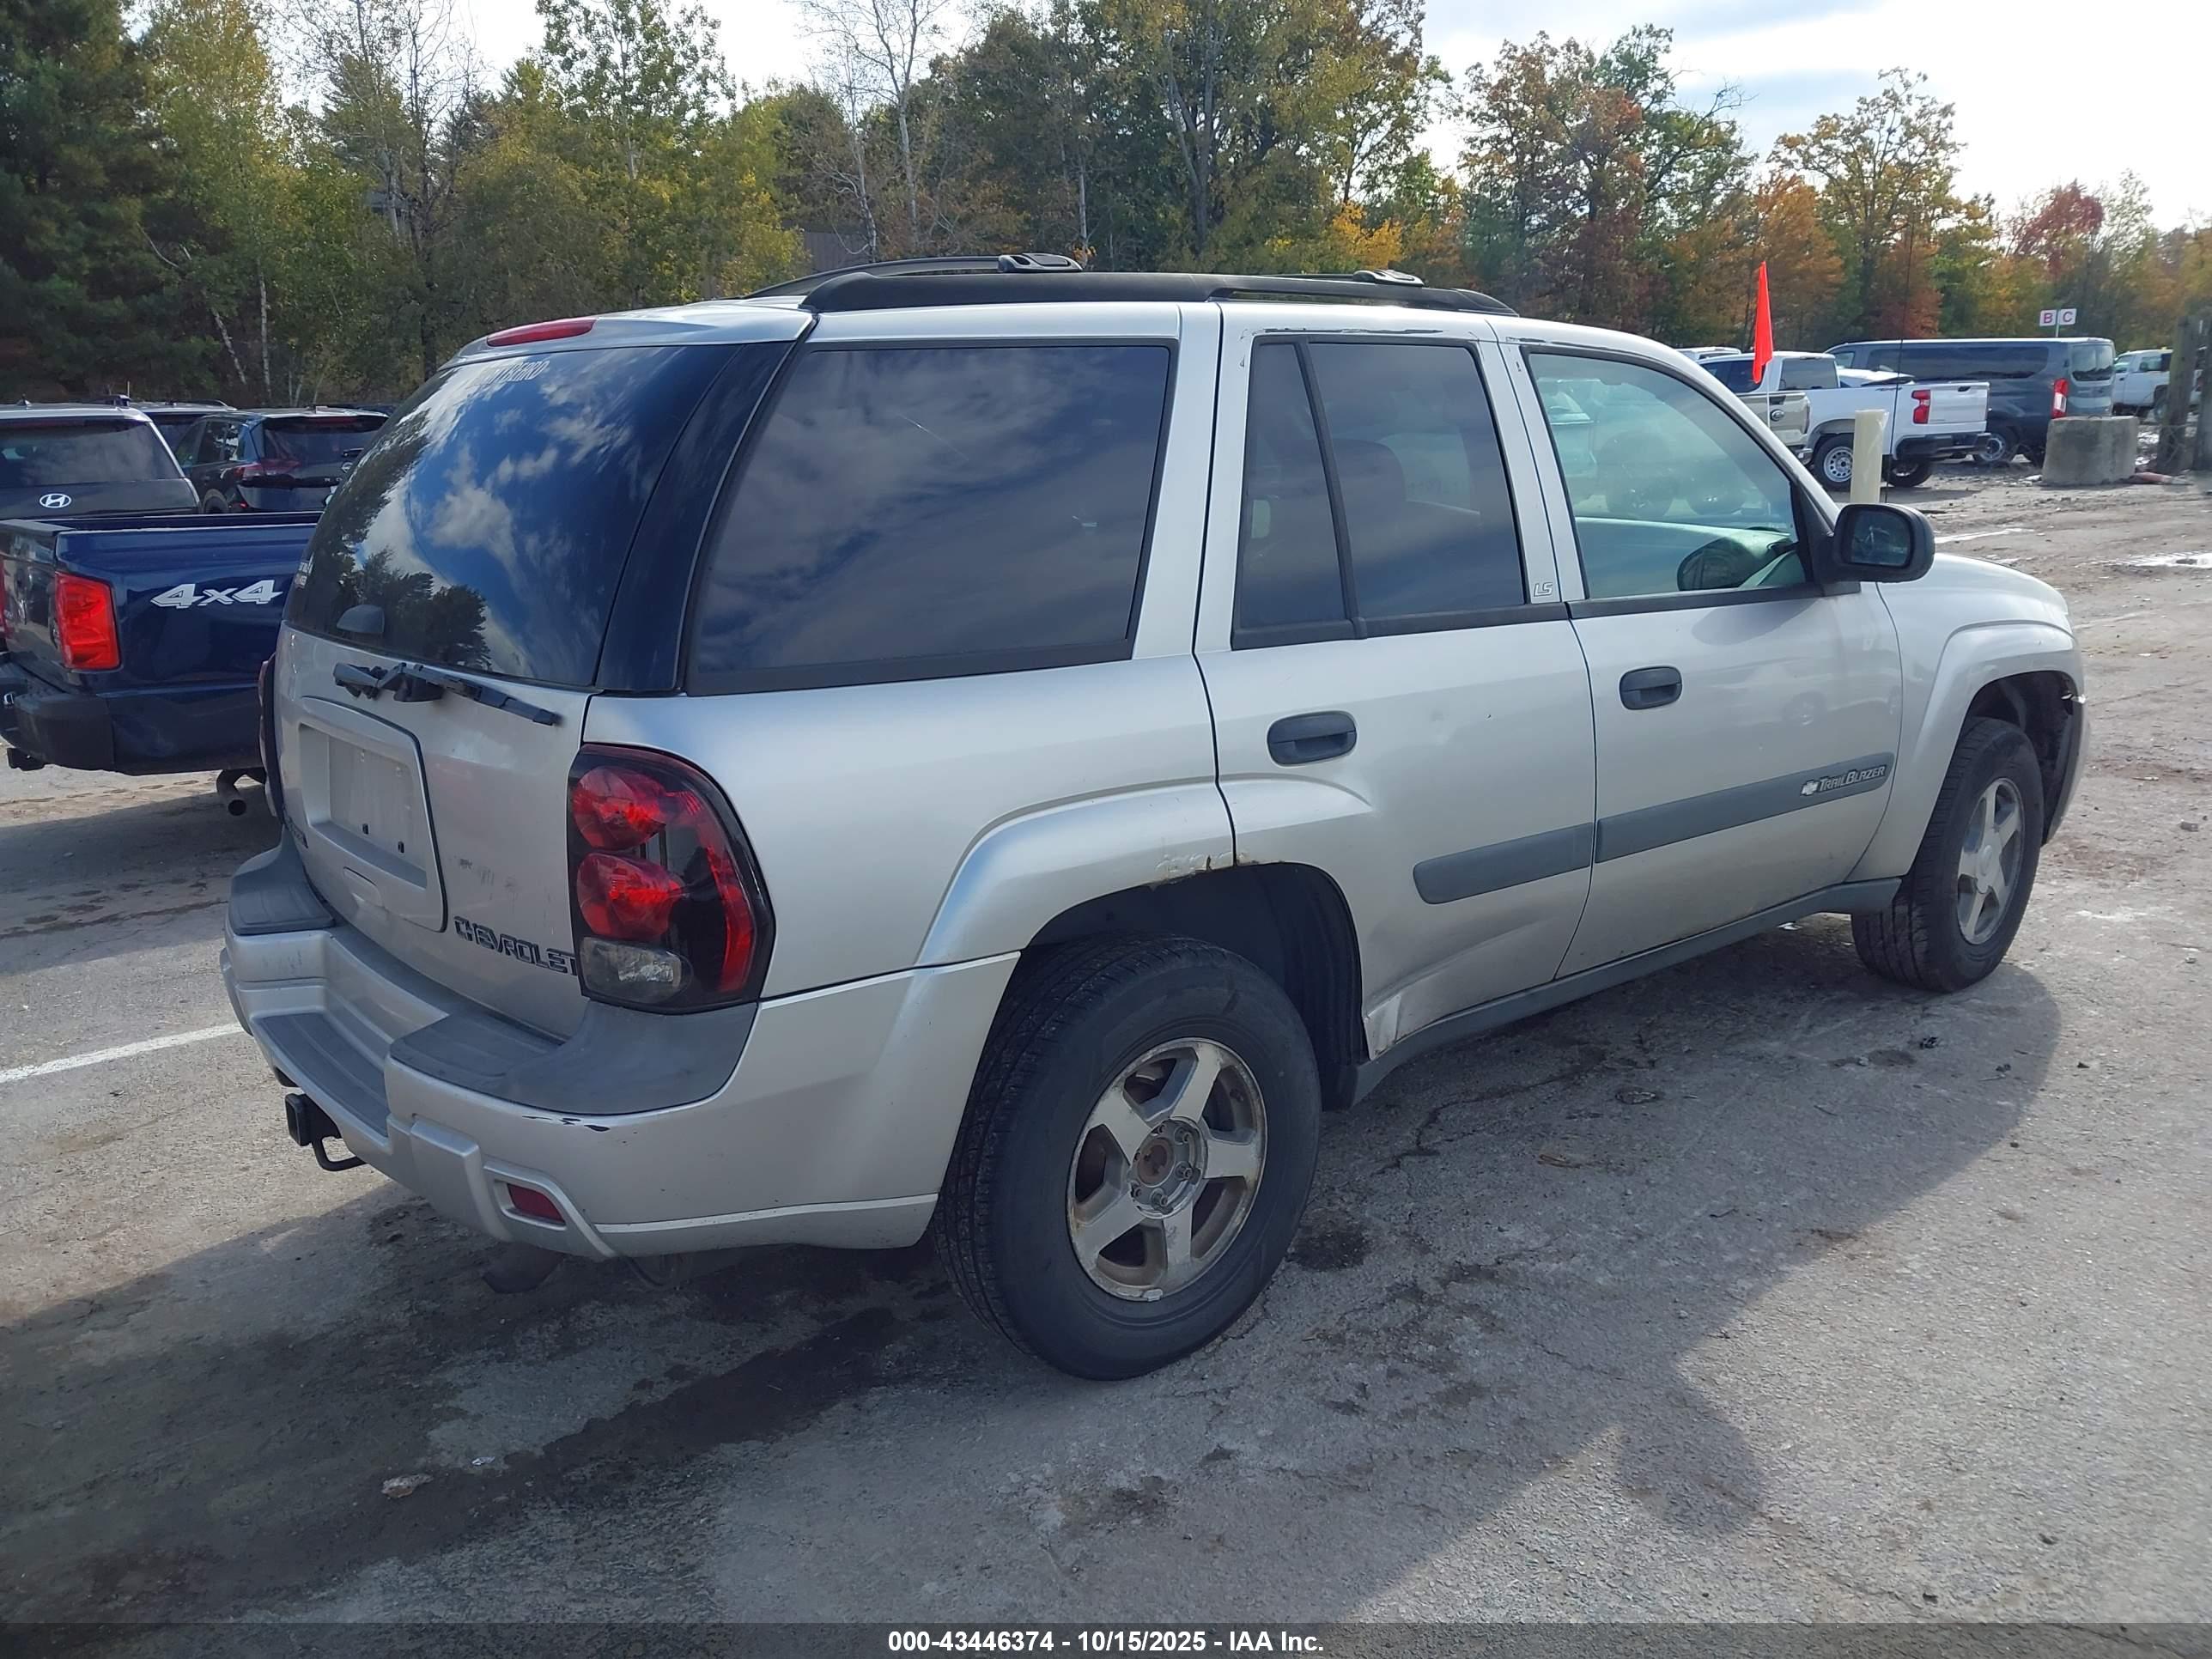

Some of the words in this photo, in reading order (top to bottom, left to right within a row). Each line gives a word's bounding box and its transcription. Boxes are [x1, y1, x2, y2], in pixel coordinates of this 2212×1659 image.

[2044, 313, 2054, 324] B
[2063, 311, 2074, 323] C
[1534, 581, 1553, 598] LS
[454, 915, 578, 976] CHEVROLET
